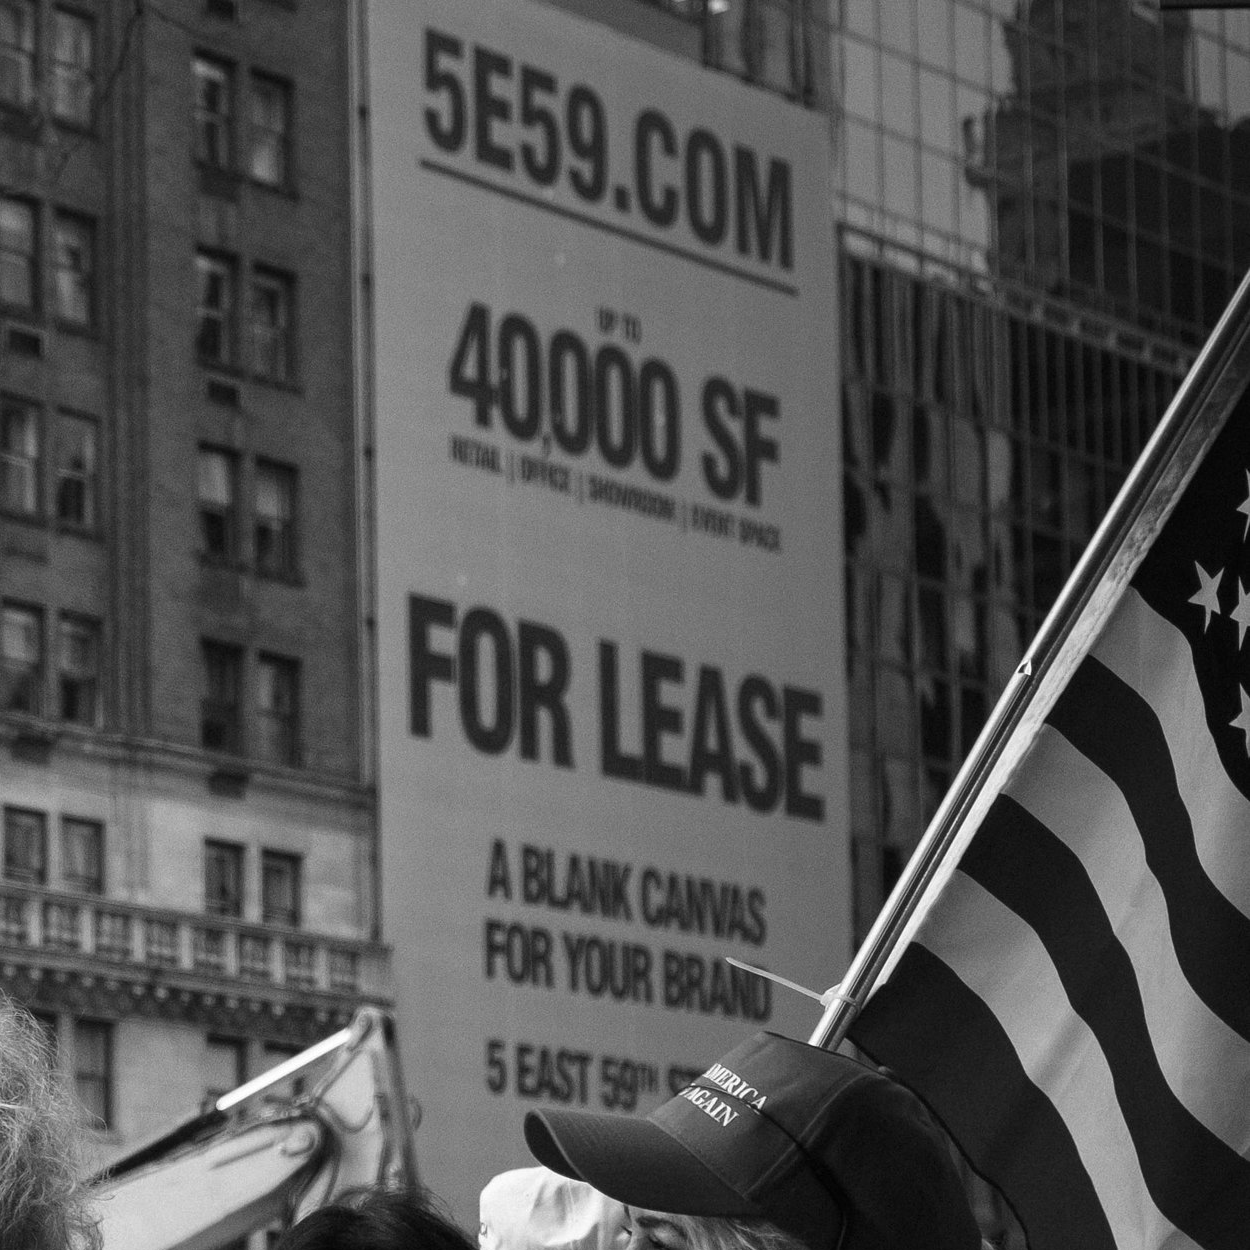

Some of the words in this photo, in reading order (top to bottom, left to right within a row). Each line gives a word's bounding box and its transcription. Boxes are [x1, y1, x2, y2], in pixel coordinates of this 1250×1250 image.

[424, 26, 793, 271] 5E59.COM
[701, 375, 781, 509] SF
[407, 591, 575, 769] FOR
[598, 637, 827, 823] LEASE
[487, 838, 513, 902] A
[519, 843, 634, 923] BLANK
[640, 866, 768, 947] CANVAS
[484, 917, 555, 990] FOR
[562, 930, 650, 1000] YOUR
[661, 949, 774, 1024] BRAND
[486, 1038, 507, 1095] 5
[515, 1042, 593, 1106] EAST
